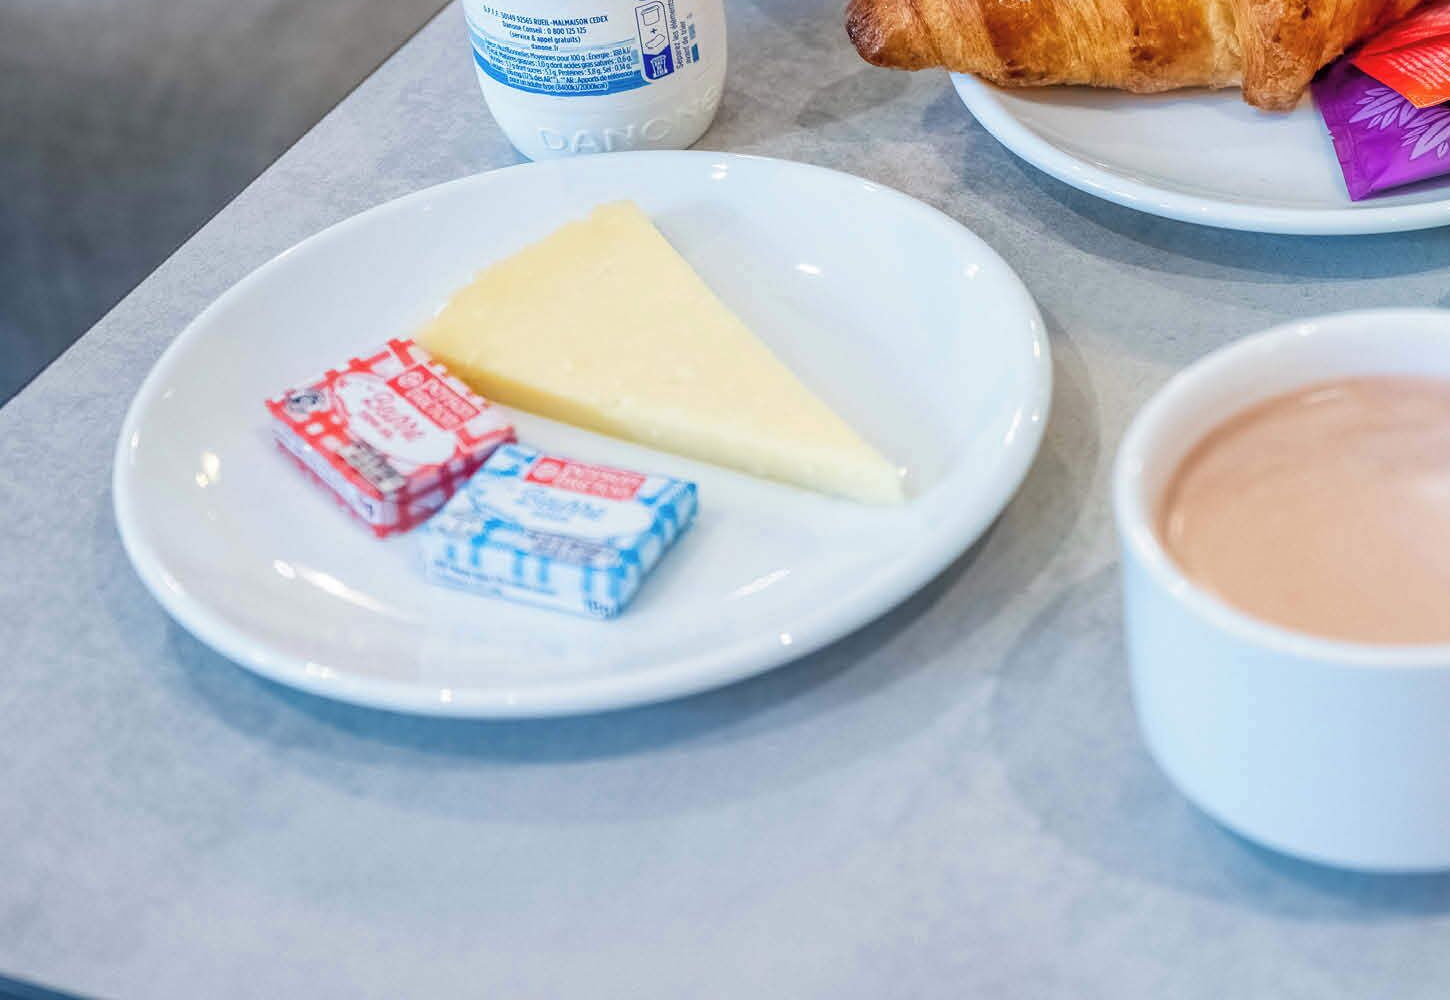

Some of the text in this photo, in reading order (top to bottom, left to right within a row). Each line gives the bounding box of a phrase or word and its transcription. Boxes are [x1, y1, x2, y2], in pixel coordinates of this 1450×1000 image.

[533, 18, 588, 26] RUEIL-MALMAISON
[589, 15, 608, 24] CEDEX
[566, 27, 576, 35] 125
[577, 26, 587, 34] 125
